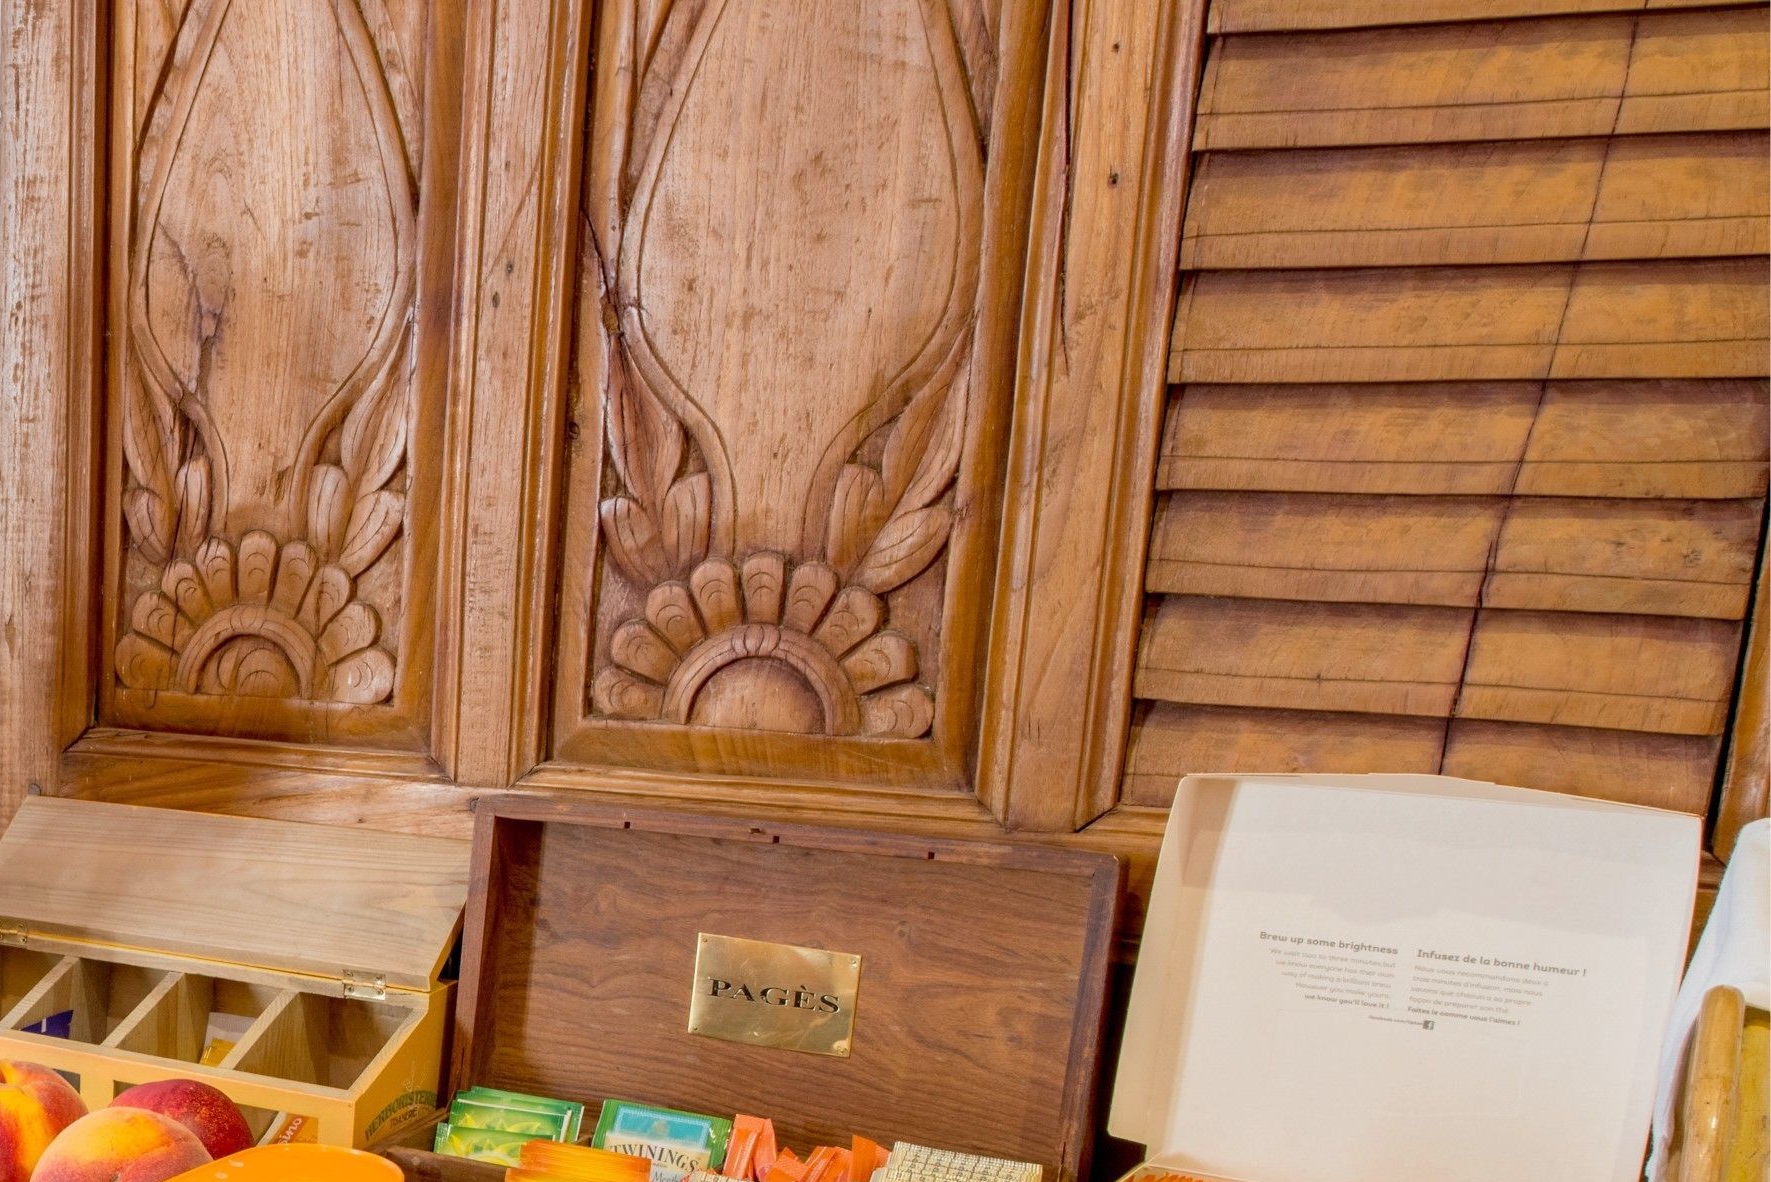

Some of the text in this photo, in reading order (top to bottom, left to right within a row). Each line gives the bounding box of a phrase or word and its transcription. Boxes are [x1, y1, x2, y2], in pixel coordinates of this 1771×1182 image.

[1260, 931, 1398, 954] Brew up some brightness
[1417, 949, 1459, 962] Infusez
[1463, 954, 1477, 964] de
[1480, 956, 1490, 965] la
[1493, 958, 1530, 970] bonne
[1533, 962, 1580, 976] humeur
[708, 976, 840, 1014] PAGÈS
[610, 1144, 699, 1172] TWININGS
